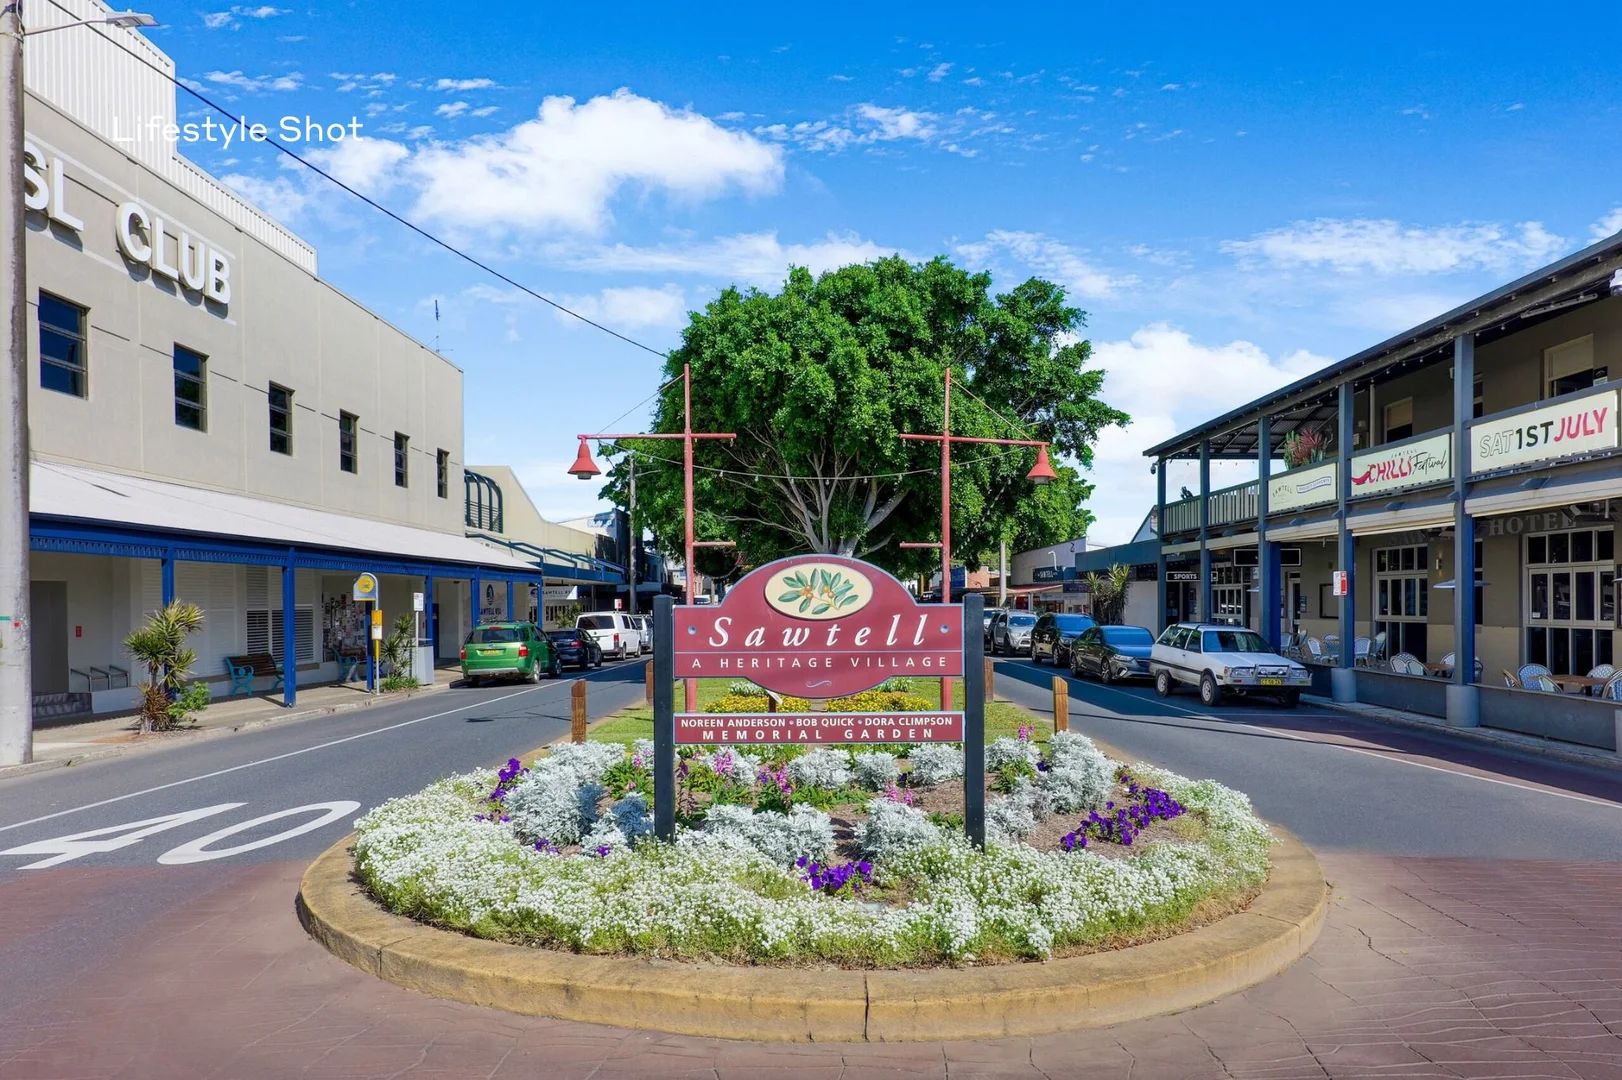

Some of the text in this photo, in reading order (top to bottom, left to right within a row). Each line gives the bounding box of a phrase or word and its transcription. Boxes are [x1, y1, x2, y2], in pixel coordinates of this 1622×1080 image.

[24, 141, 232, 304] SL CLUB
[1480, 407, 1608, 458] SAT 1ST JULY
[1489, 511, 1577, 537] HOTEL
[708, 613, 929, 647] Sawtell
[692, 656, 946, 669] A HERITAGE VILLAGE
[681, 717, 953, 728] NOREEN ANDERSON BOB QUICK DORA CLIMPSON
[702, 728, 933, 740] MEMORIAL GARDEN
[0, 800, 361, 870] 40
